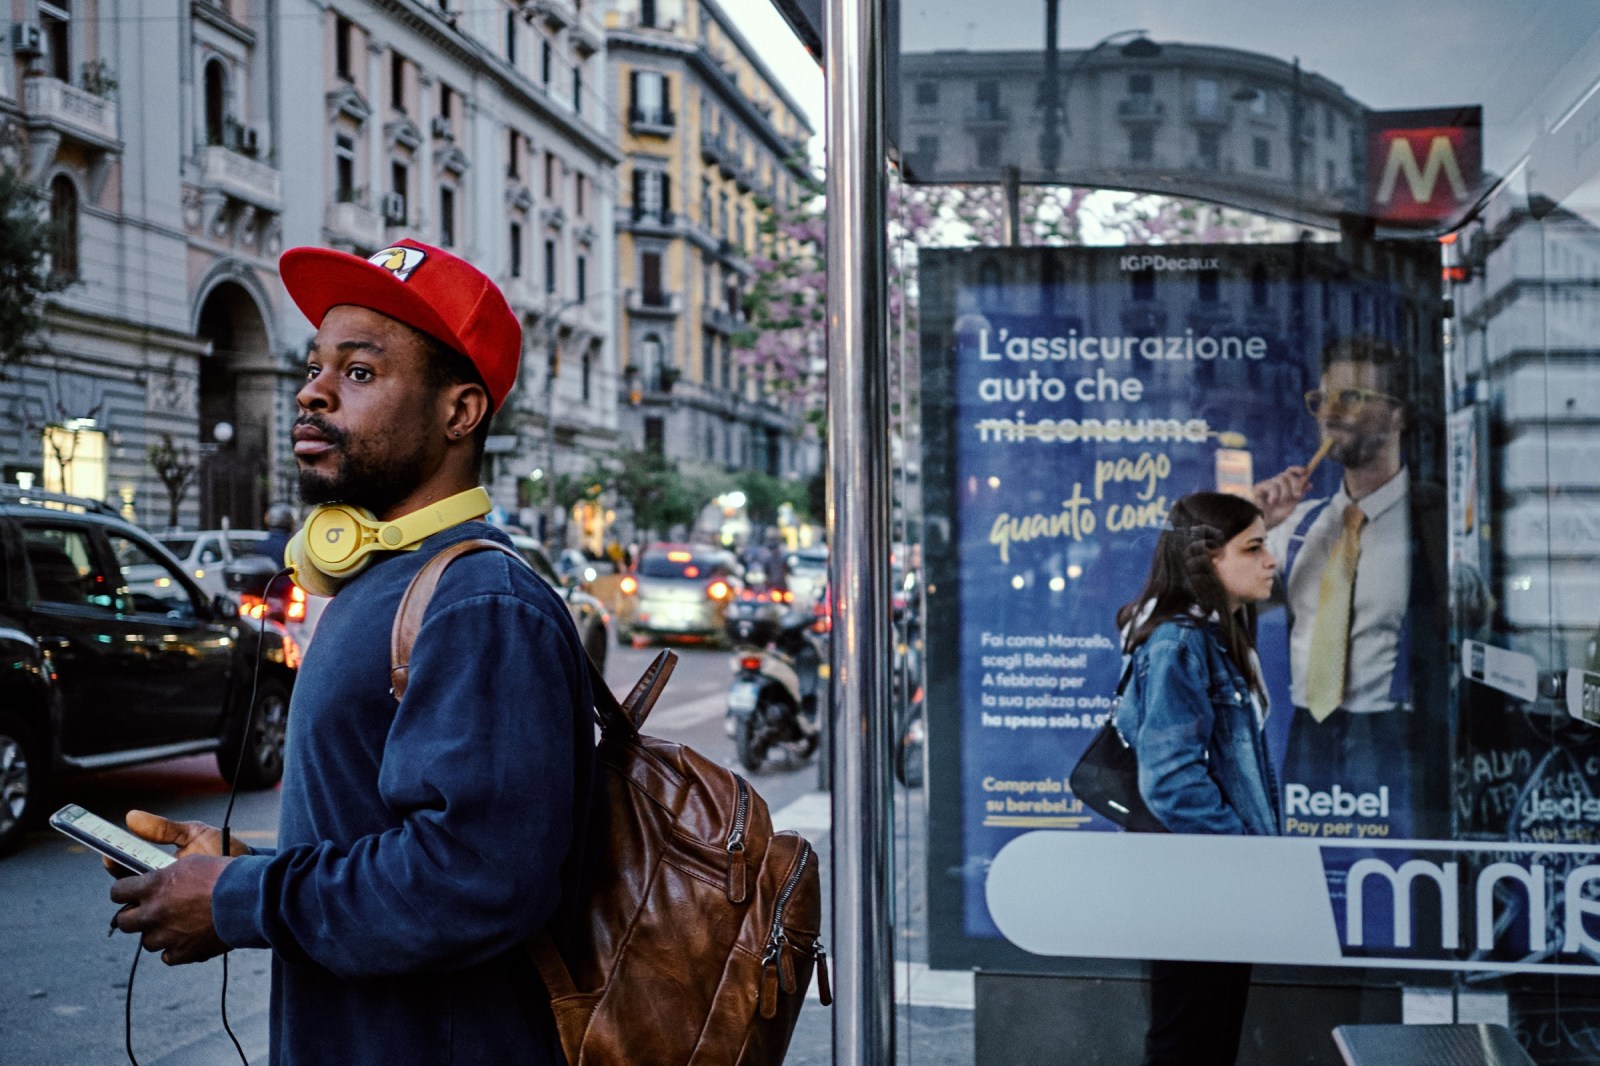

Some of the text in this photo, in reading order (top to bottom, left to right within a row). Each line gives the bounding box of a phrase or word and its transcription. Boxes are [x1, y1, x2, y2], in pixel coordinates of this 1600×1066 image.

[1377, 136, 1467, 203] M
[1121, 255, 1219, 271] IGPDecaux
[979, 328, 1267, 361] L'assicurazione
[979, 368, 1143, 402] auto che
[979, 410, 1209, 443] mi consuma
[1095, 452, 1172, 501] pago
[989, 482, 1170, 564] quanto cons
[981, 632, 1115, 650] Fai come Marcello,
[981, 652, 1088, 670] scegli BeRebel!
[982, 673, 1086, 690] A febbraio per
[981, 692, 1111, 710] la sua polizza auto
[981, 712, 1002, 728] ha
[1004, 715, 1047, 730] speso
[1049, 713, 1080, 728] solo
[982, 776, 1062, 794] Comprala
[985, 797, 1084, 813] su berebel.it
[1285, 783, 1389, 817] Rebel
[1286, 817, 1389, 838] Pay per you
